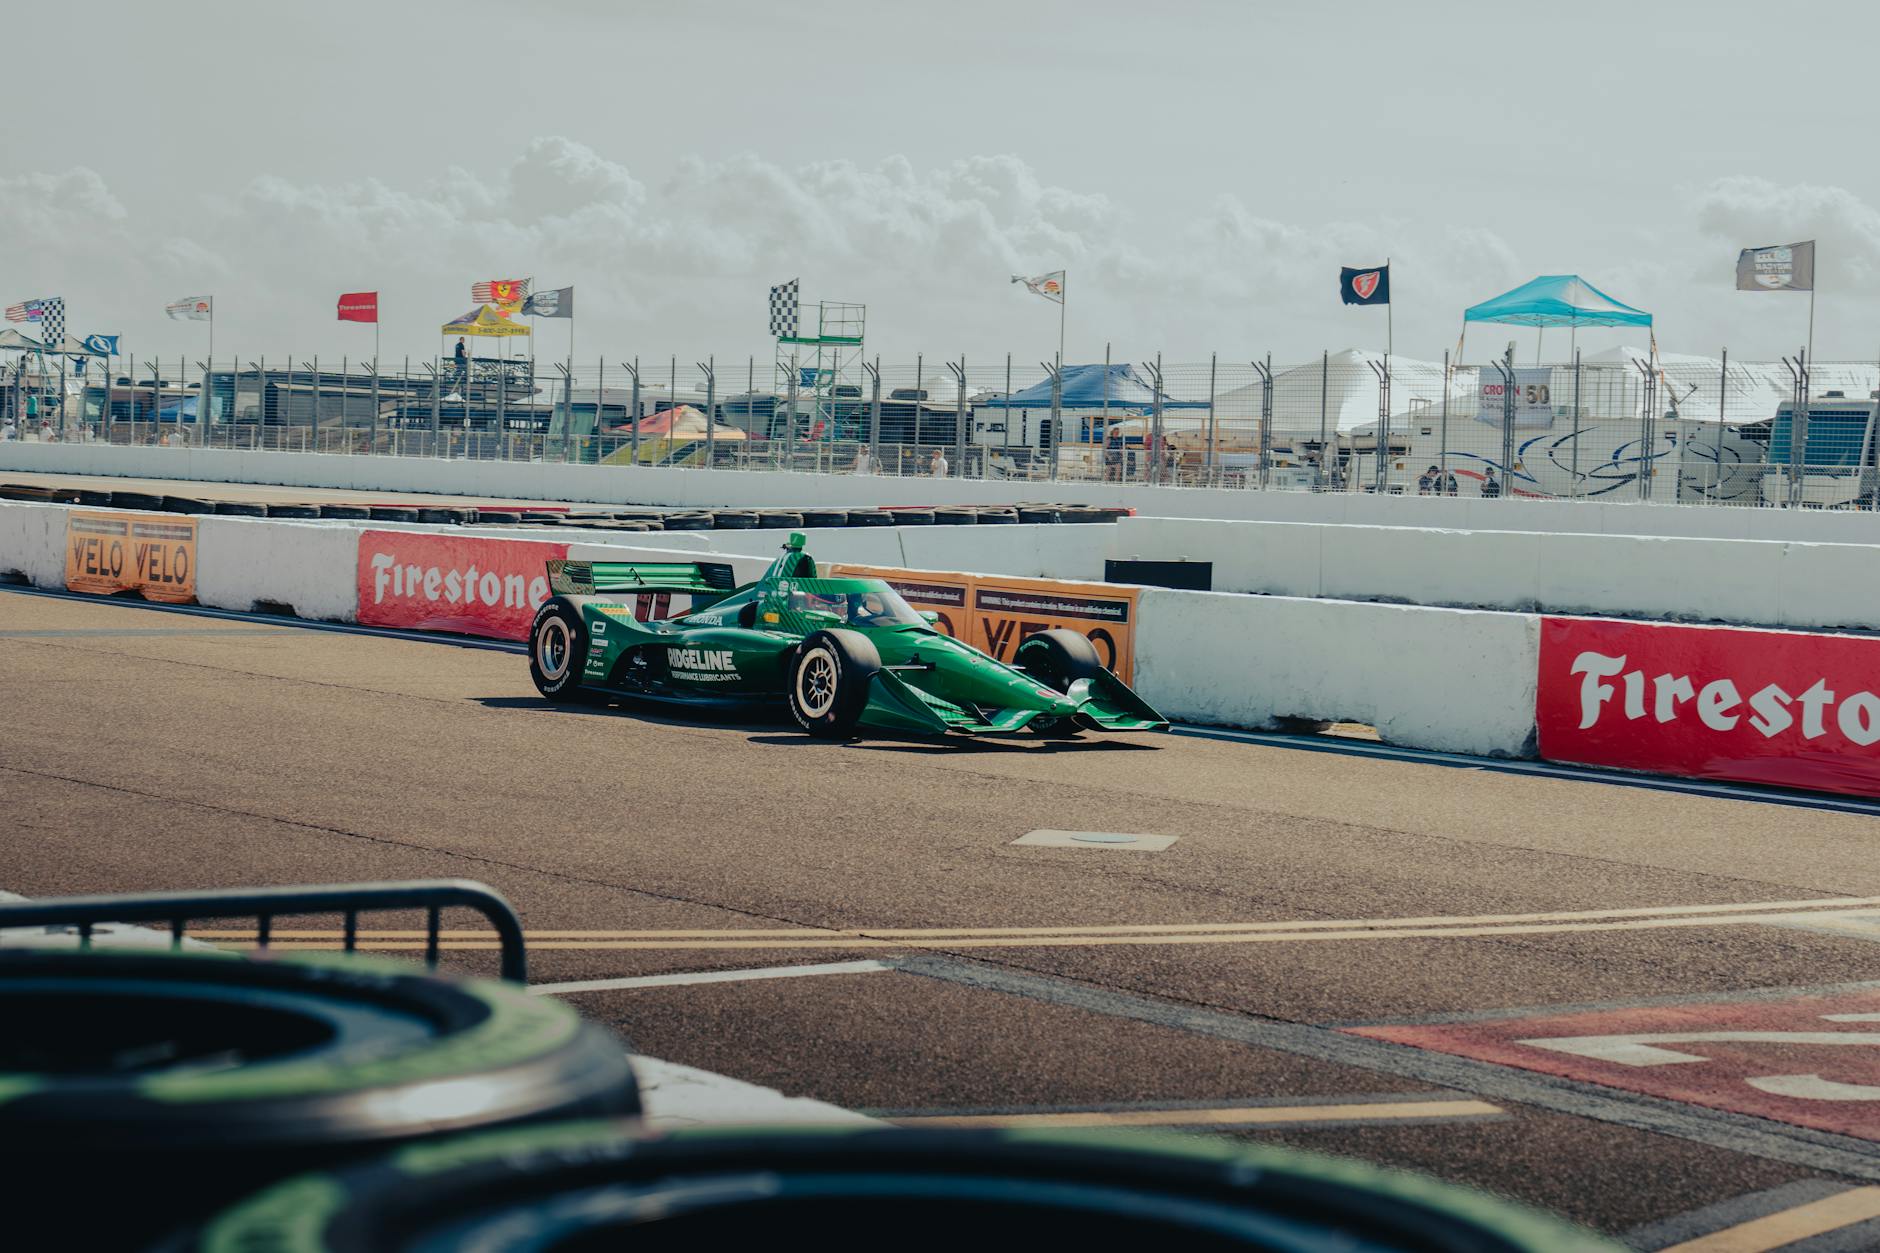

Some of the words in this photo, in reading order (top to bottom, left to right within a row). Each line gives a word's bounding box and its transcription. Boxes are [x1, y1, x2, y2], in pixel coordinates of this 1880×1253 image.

[72, 536, 123, 578] VELO
[134, 543, 189, 585] VELO
[371, 553, 550, 611] Firestone
[667, 648, 737, 671] RIDGELINE
[700, 673, 742, 681] LUBRICANTS
